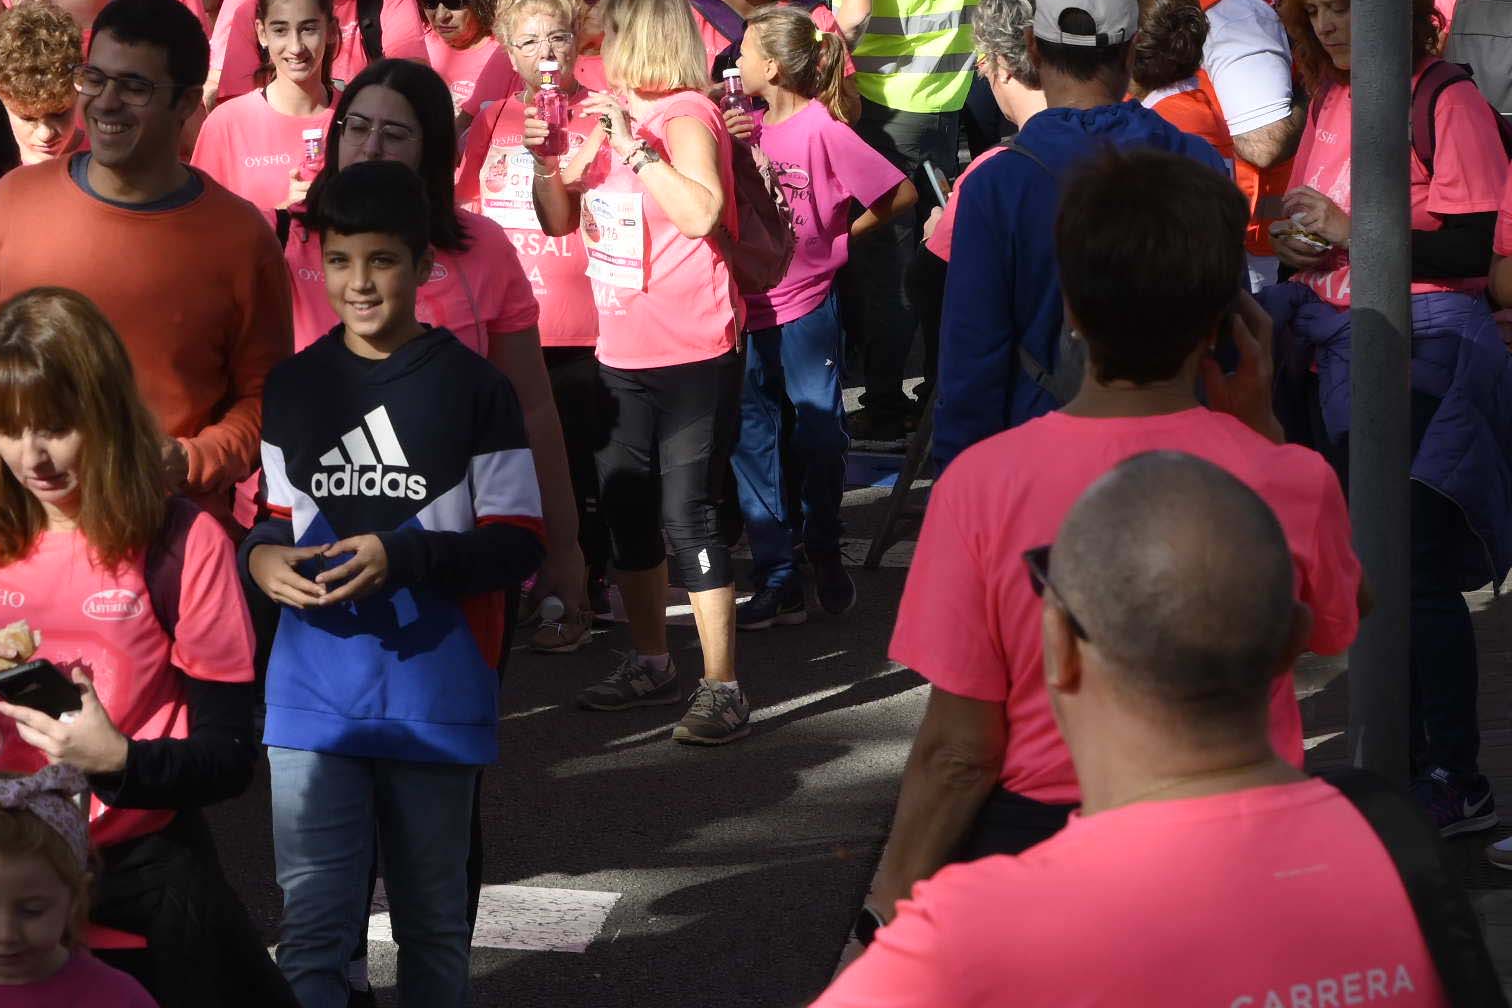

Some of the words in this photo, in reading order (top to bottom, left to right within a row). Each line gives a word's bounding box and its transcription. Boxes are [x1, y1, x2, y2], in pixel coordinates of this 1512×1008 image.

[244, 153, 290, 169] OYSHO
[514, 233, 572, 257] RSAL
[311, 463, 427, 501] adidas
